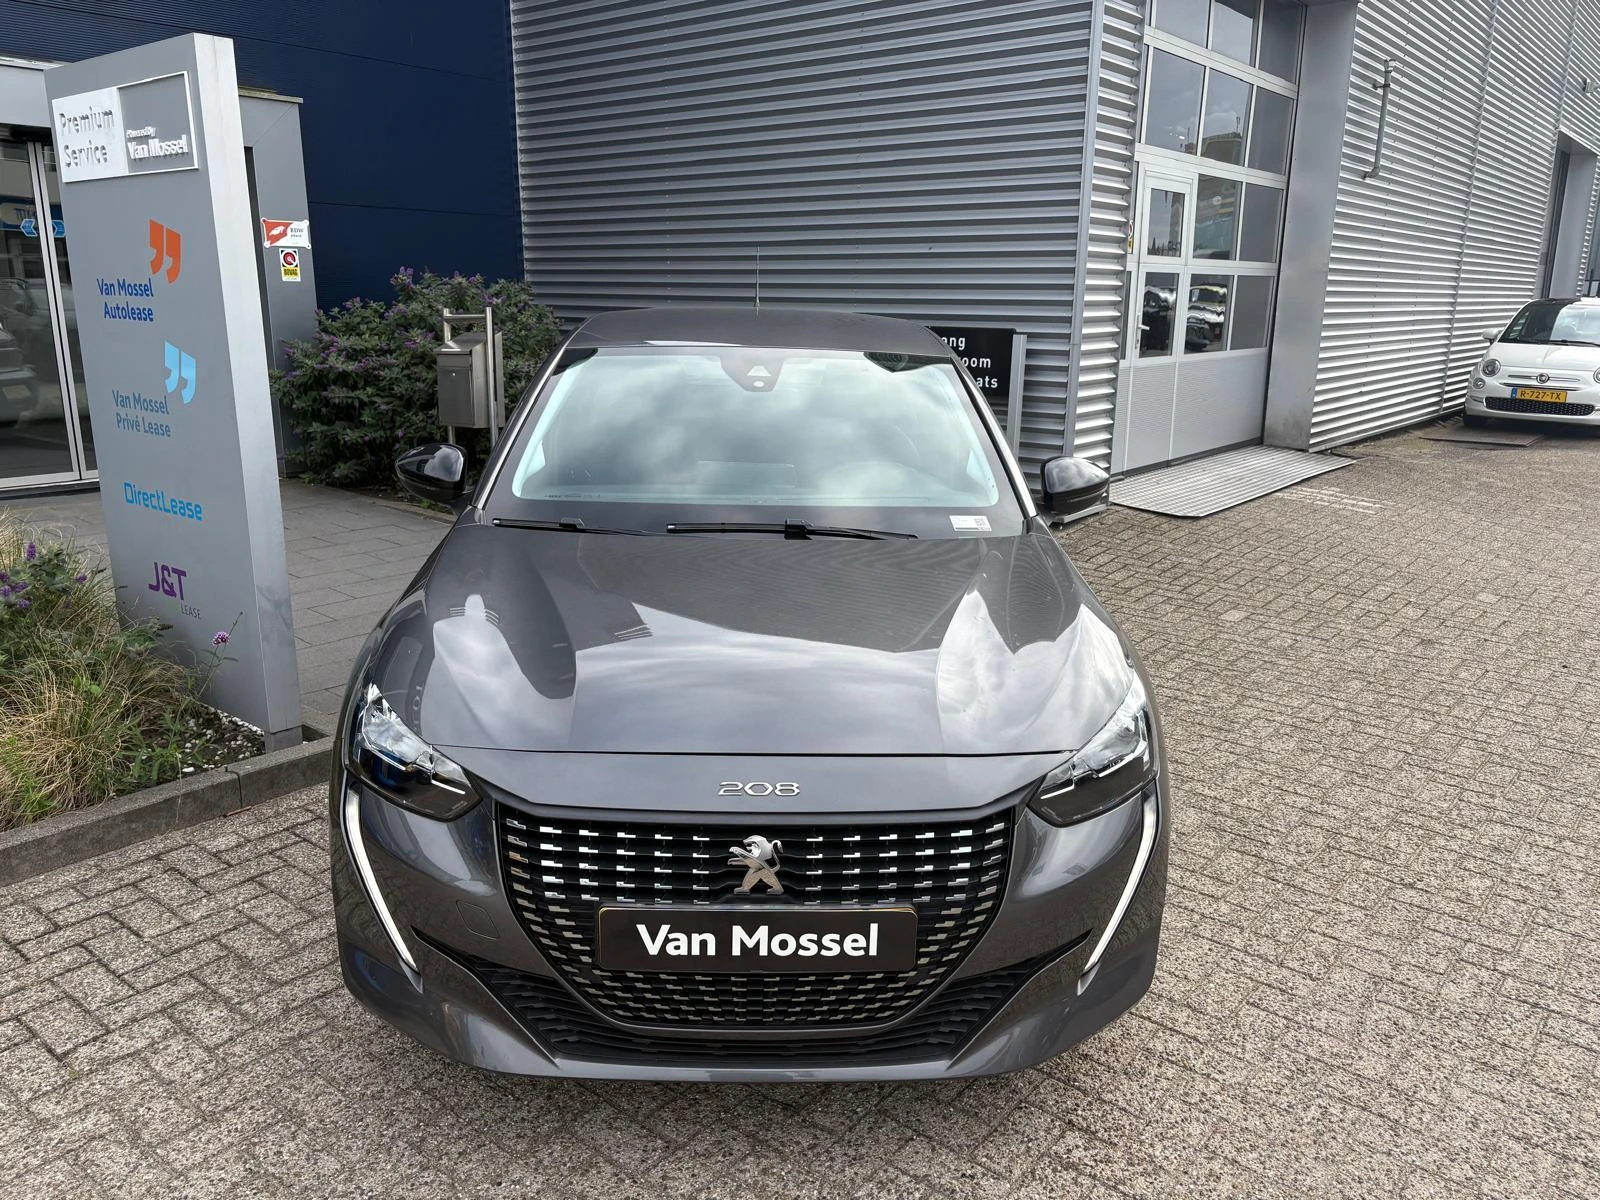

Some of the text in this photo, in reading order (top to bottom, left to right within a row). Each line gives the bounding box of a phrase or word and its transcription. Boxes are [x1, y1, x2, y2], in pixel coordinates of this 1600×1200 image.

[59, 106, 114, 136] Premium
[63, 140, 108, 168] Service
[127, 134, 189, 160] Van Mossel
[96, 277, 154, 297] Van Mossel
[104, 301, 154, 322] Autolease
[958, 356, 991, 369] oom
[111, 389, 170, 415] Van Mossel
[115, 412, 171, 437] Privé Lease
[123, 482, 203, 521] DirectLease
[148, 562, 187, 601] J&T
[180, 603, 202, 620] LEASE
[717, 781, 801, 797] 208
[635, 922, 880, 957] Van Mossel
